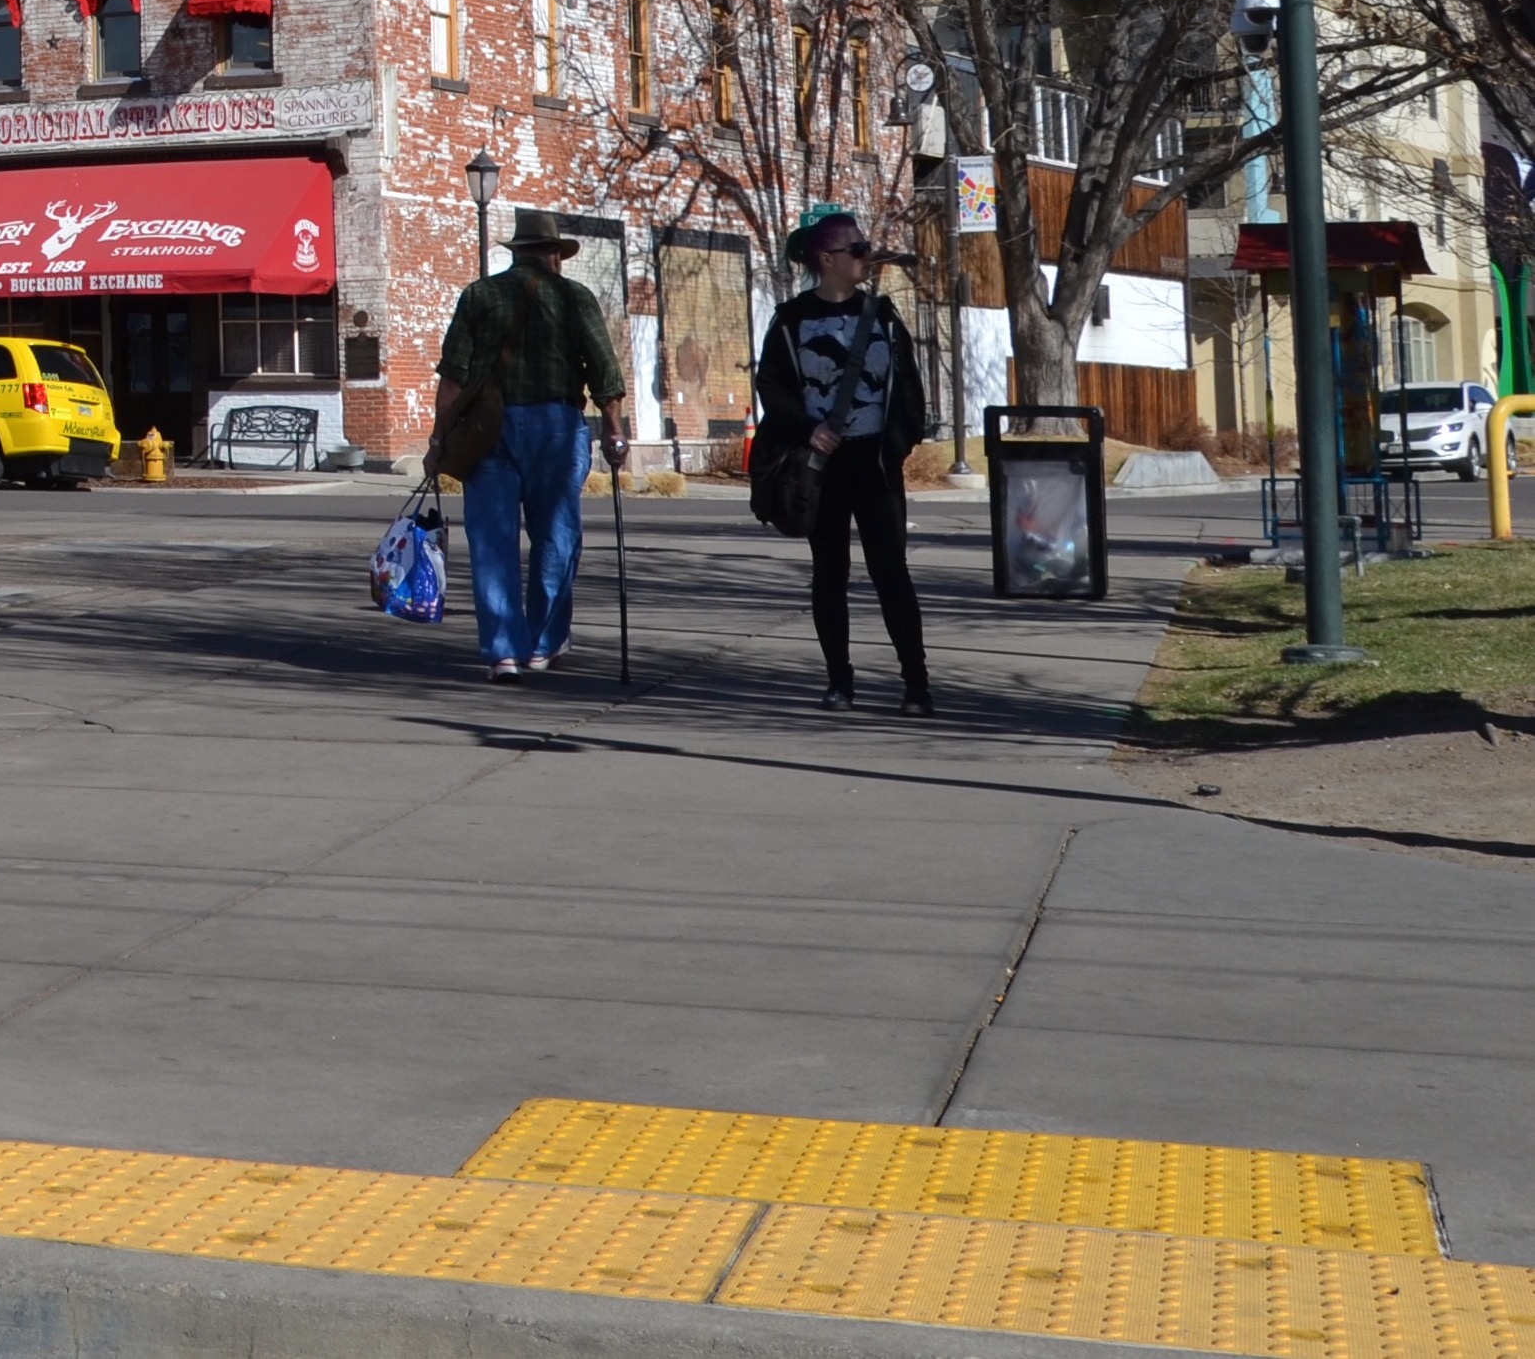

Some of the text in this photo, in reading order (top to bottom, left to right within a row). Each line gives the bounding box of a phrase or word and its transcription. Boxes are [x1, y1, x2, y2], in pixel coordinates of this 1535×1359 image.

[284, 94, 361, 114] SPANNING 3
[114, 96, 275, 139] STEAKHOUSE
[288, 110, 358, 128] CENTURIES
[98, 219, 246, 248] EXCHANGE
[111, 246, 216, 257] STEAKHOUSE
[44, 260, 86, 273] 1893
[10, 276, 83, 293] BUCKHORN
[90, 274, 164, 291] EXCHANGE
